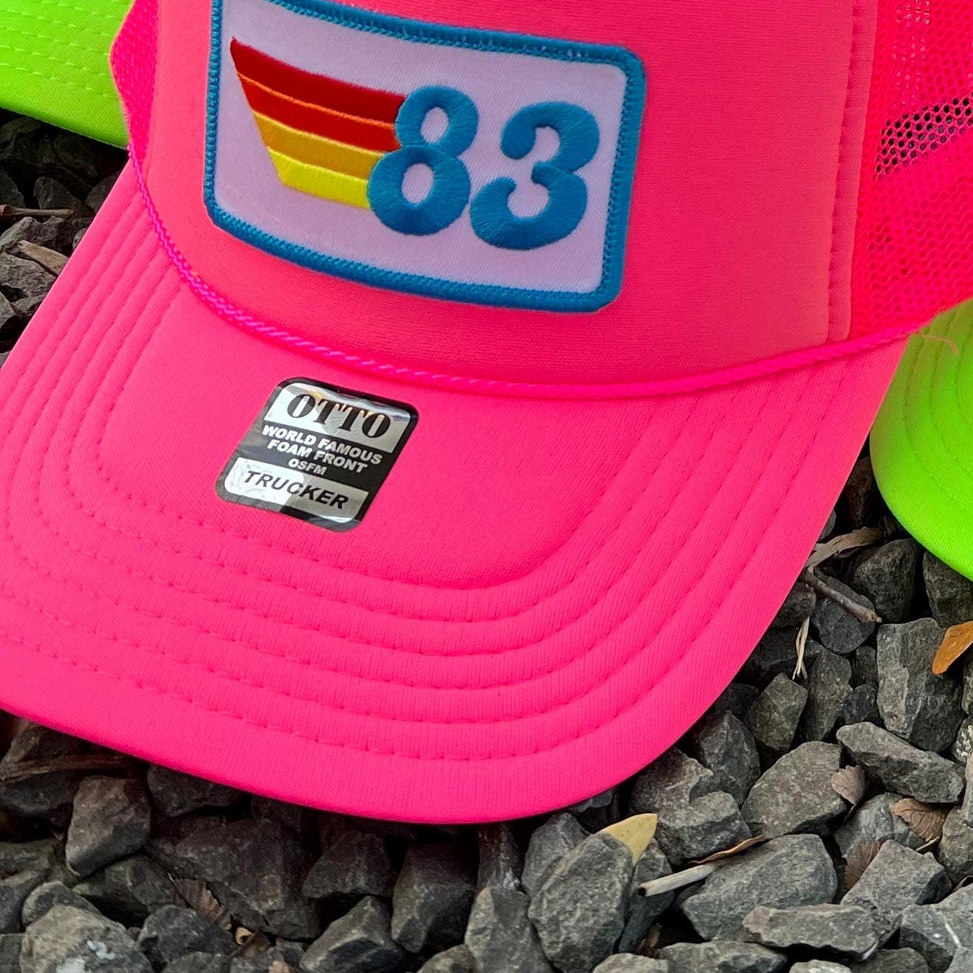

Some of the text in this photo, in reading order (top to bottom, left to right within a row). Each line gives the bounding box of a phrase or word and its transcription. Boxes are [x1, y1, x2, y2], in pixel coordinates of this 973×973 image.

[366, 84, 600, 251] 83
[286, 393, 391, 439] OTTO
[262, 424, 383, 465] WORLD FAMOUS
[267, 439, 368, 474] FOAM FRONT
[287, 458, 328, 476] OSFM
[244, 469, 350, 510] TRUCKER
